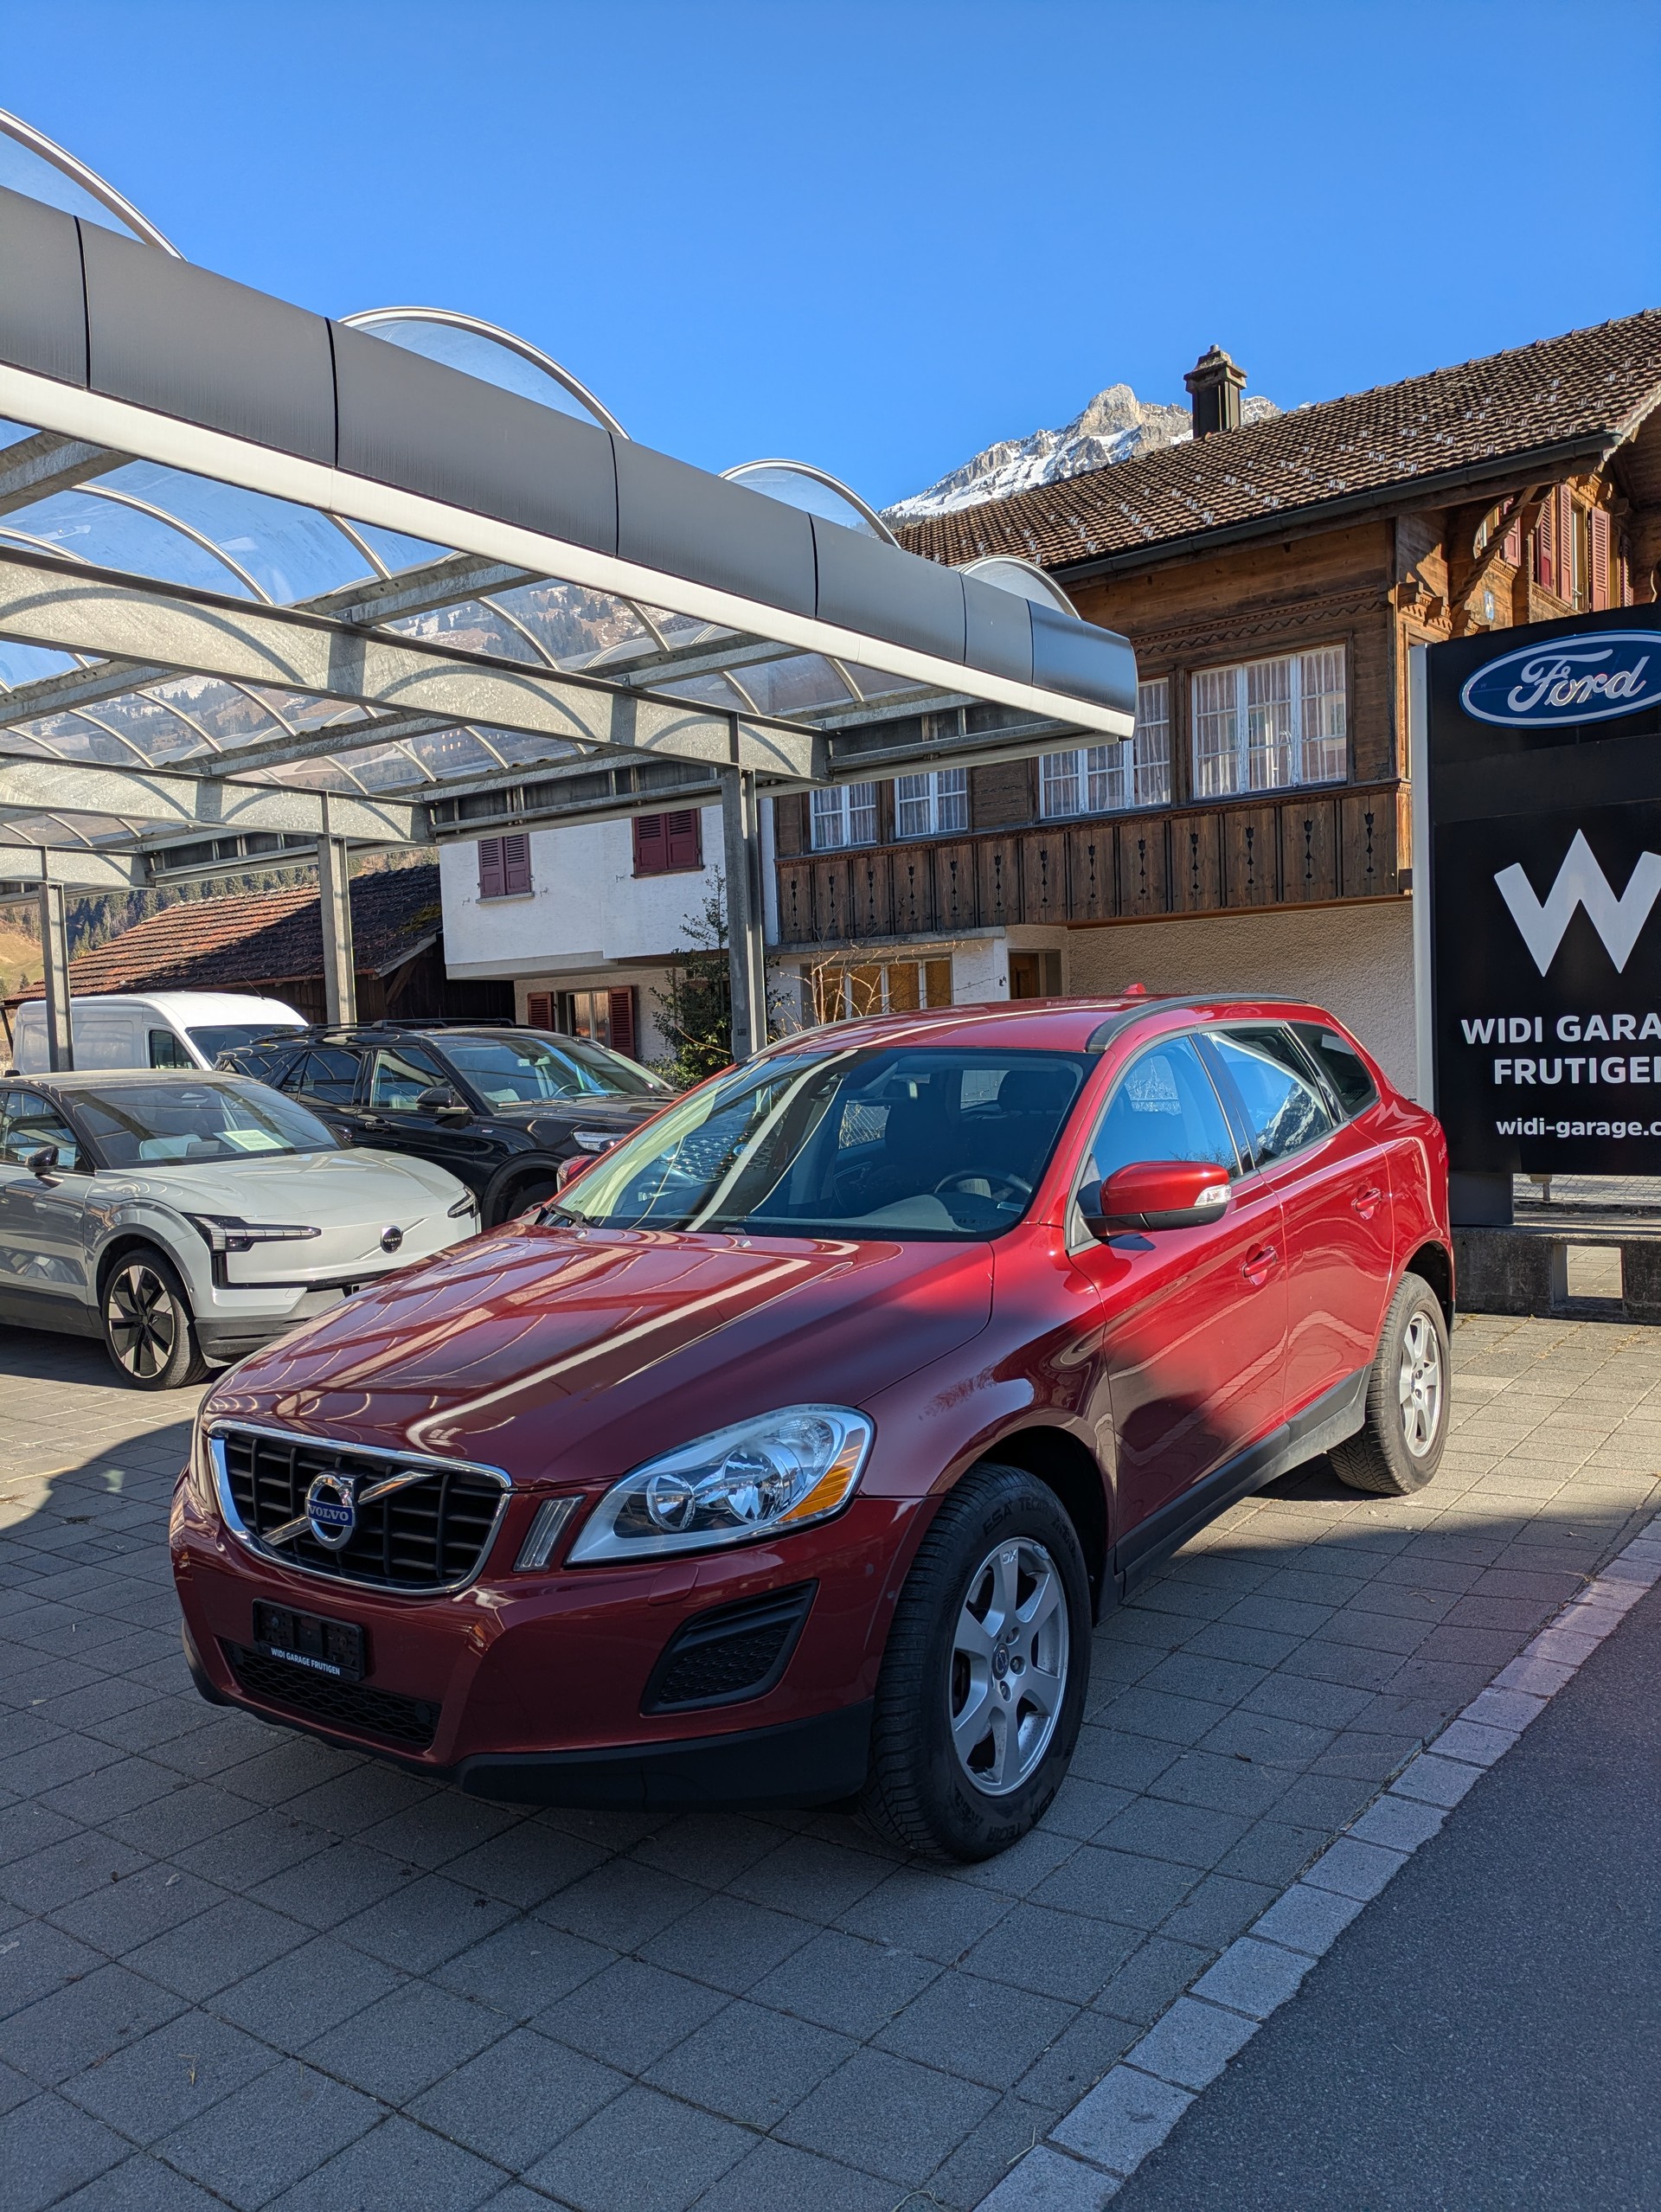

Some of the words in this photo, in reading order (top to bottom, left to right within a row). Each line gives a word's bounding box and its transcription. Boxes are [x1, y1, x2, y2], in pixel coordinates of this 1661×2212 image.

[1508, 649, 1650, 713] Ford
[1494, 828, 1661, 977] W
[1461, 1016, 1542, 1044] WIDI
[1556, 1013, 1661, 1042] GARA
[1494, 1056, 1661, 1085] FRUTIGE
[1496, 1118, 1661, 1138] widi-garage.c
[308, 1504, 349, 1521] VOLVO
[271, 1647, 285, 1659] WIDI
[286, 1652, 310, 1667] GARAGE
[311, 1659, 341, 1676] FRUTIGEN
